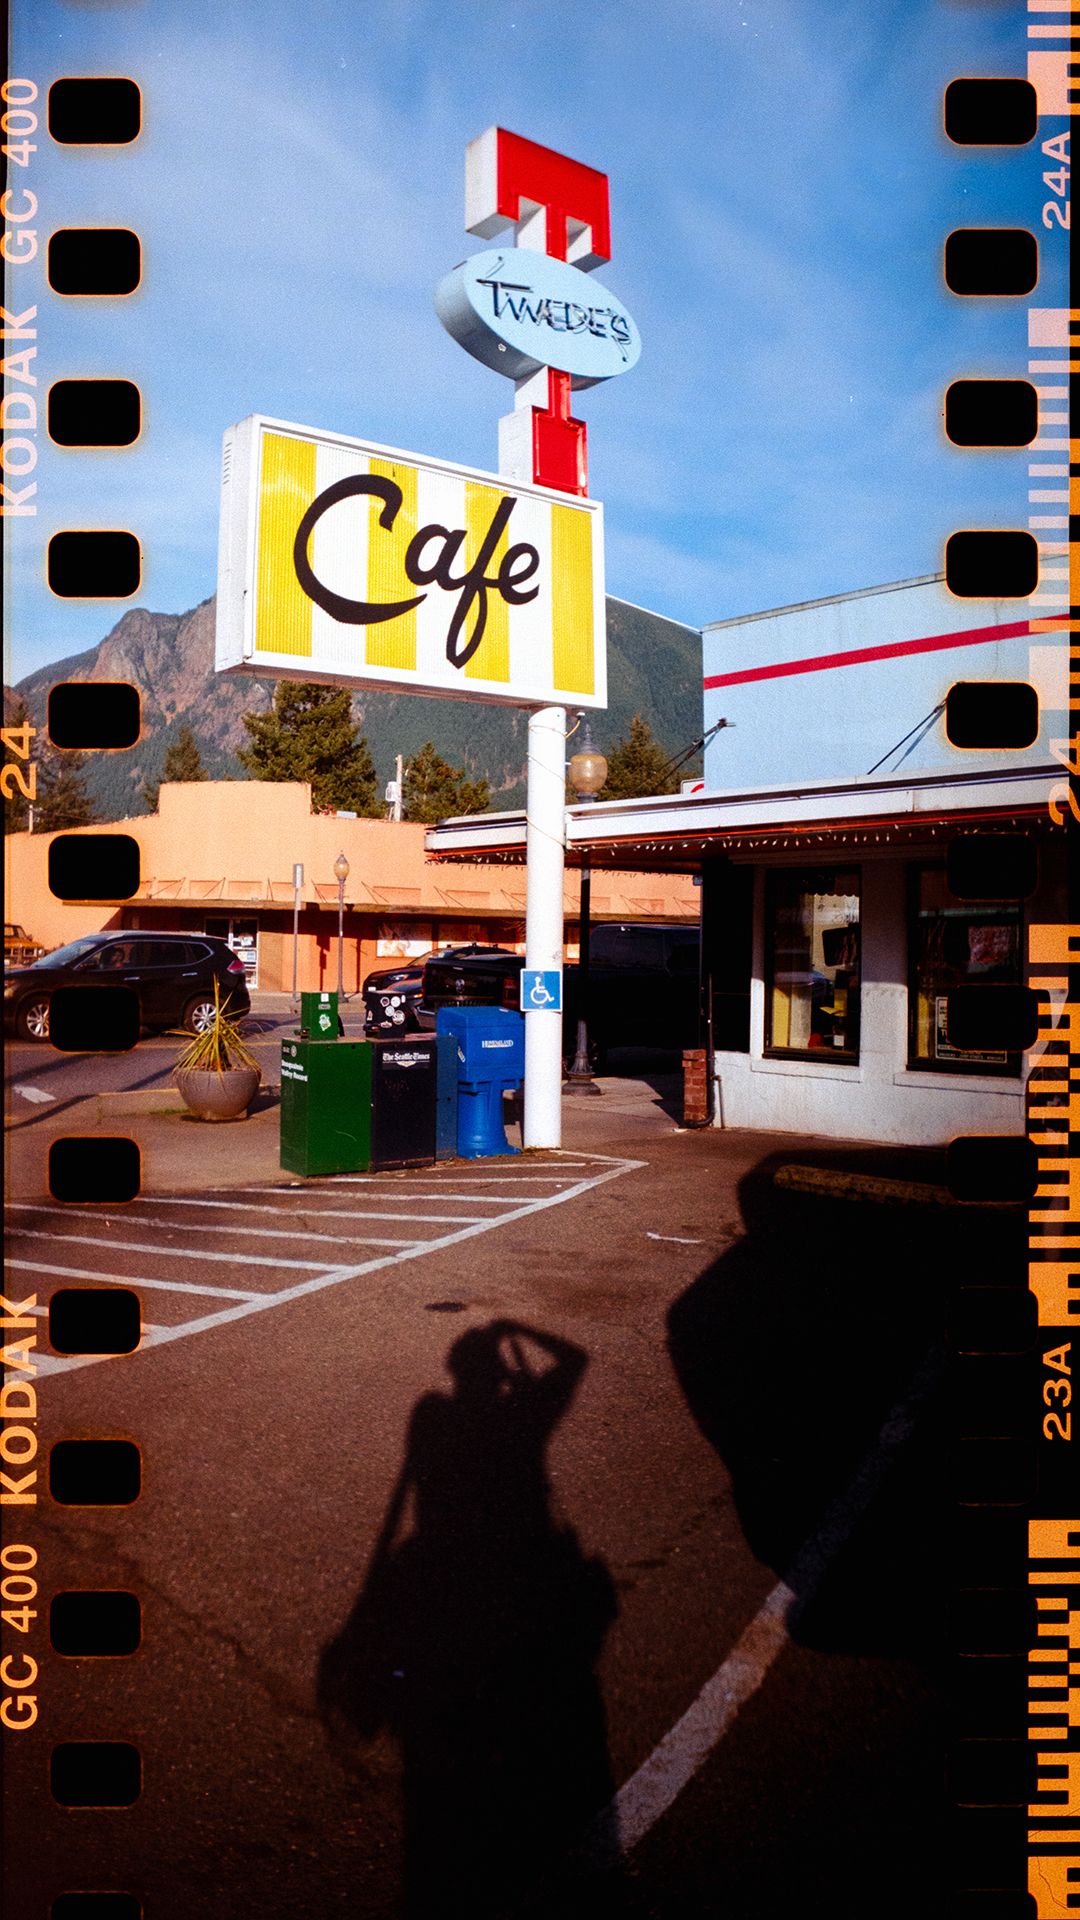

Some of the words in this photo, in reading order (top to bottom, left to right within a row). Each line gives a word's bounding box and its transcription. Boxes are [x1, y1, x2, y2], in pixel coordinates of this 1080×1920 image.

[293, 473, 540, 669] Cafe
[382, 1052, 394, 1061] The
[394, 1052, 412, 1061] Seattle
[412, 1052, 430, 1060] Times
